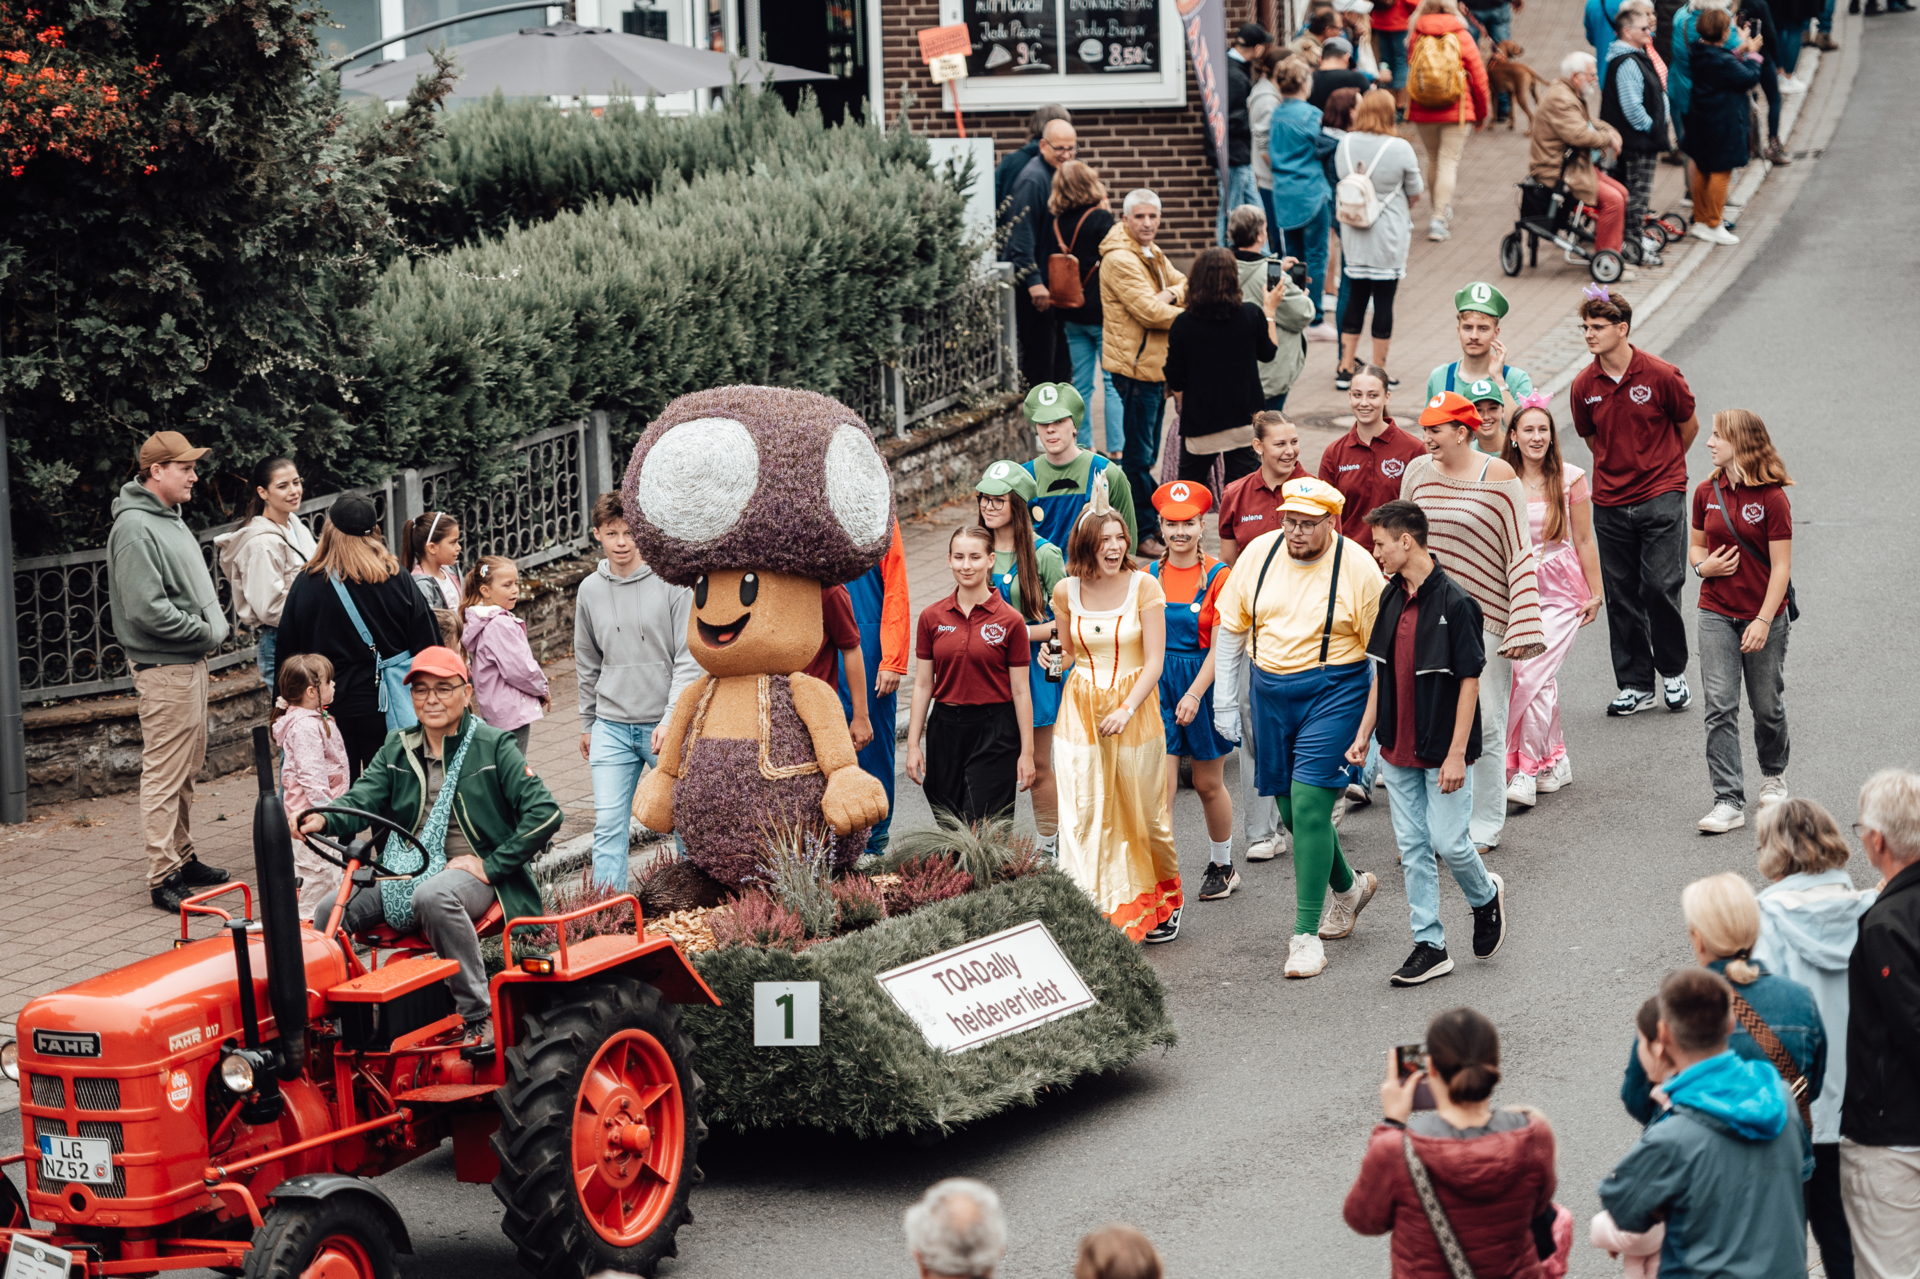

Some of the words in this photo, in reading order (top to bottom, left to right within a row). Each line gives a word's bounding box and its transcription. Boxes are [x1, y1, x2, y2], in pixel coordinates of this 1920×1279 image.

[1106, 18, 1147, 45] Burger
[1477, 286, 1486, 300] L
[1043, 389, 1053, 402] L
[1477, 382, 1487, 392] L
[994, 465, 1002, 476] L
[1172, 486, 1188, 497] M
[932, 951, 1022, 996] TOADally
[775, 993, 794, 1040] 1
[37, 1033, 95, 1054] FAHR
[168, 1026, 202, 1053] FAHR
[205, 1023, 219, 1039] D17
[60, 1140, 83, 1160] LG
